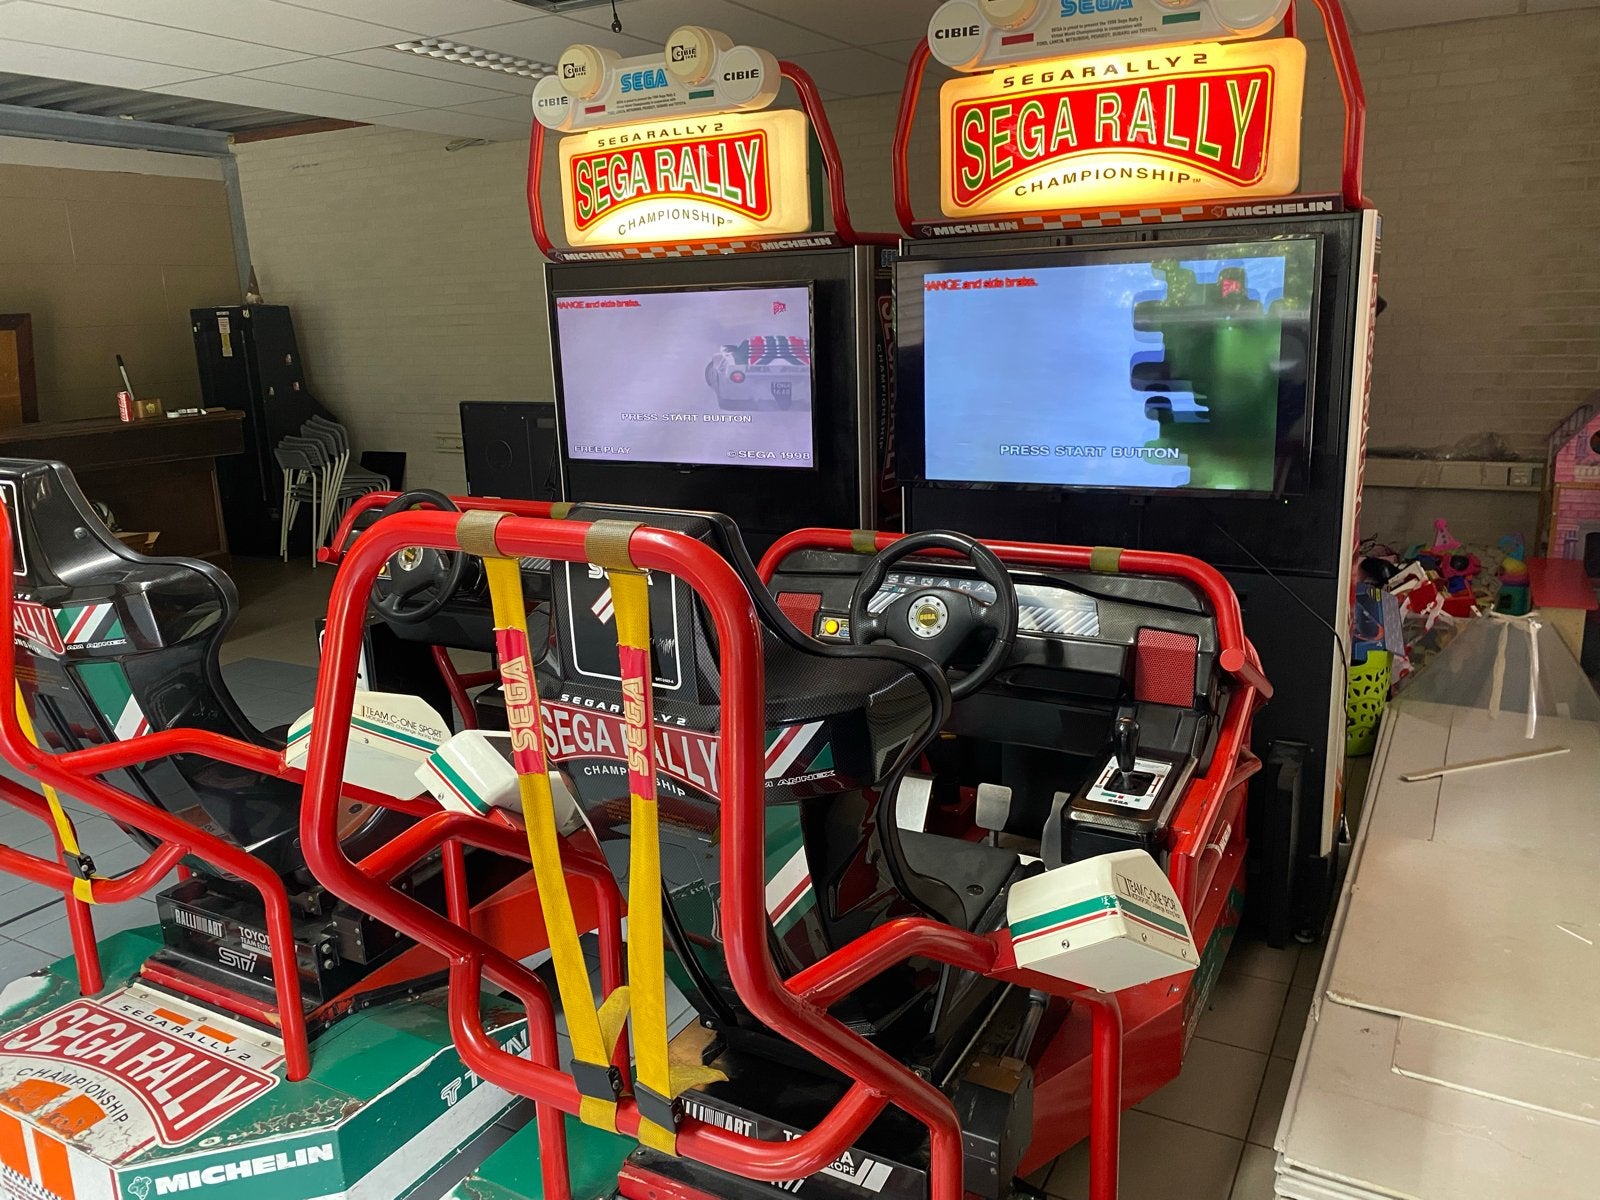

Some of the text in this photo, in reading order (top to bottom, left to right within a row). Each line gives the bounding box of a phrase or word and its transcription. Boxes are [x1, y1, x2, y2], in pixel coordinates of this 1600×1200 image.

[1193, 53, 1208, 65] 2
[620, 69, 669, 93] SEGA
[713, 123, 724, 132] 2
[960, 79, 1261, 190] SEGA RALLY
[576, 139, 761, 219] SEGA RALLY
[1225, 200, 1333, 216] MICHELIN
[933, 220, 1019, 236] MICHELIN
[762, 237, 832, 250] MICHELIN
[562, 251, 624, 262] MICHELIN
[962, 279, 982, 289] and
[983, 278, 1003, 289] side
[621, 413, 752, 423] PRESS START BUTTON
[574, 445, 631, 454] FREE PLAY
[781, 451, 810, 460] 1998
[1000, 444, 1180, 459] PRESS START BUTTON
[500, 656, 539, 752] SEGA
[560, 693, 687, 726] SEGARY 2
[366, 706, 442, 738] TEAM C-ONE SPORT
[622, 676, 649, 777] SEGA
[540, 705, 616, 757] SEGA
[584, 765, 686, 797] CHAMPSHIP
[240, 936, 256, 947] TEAM
[237, 1053, 252, 1061] 2
[3, 1007, 146, 1065] SEGA
[115, 1041, 261, 1131] RALLY
[16, 1067, 129, 1124] CHAMPIONSHIP
[155, 1144, 334, 1195] MICHELIN
